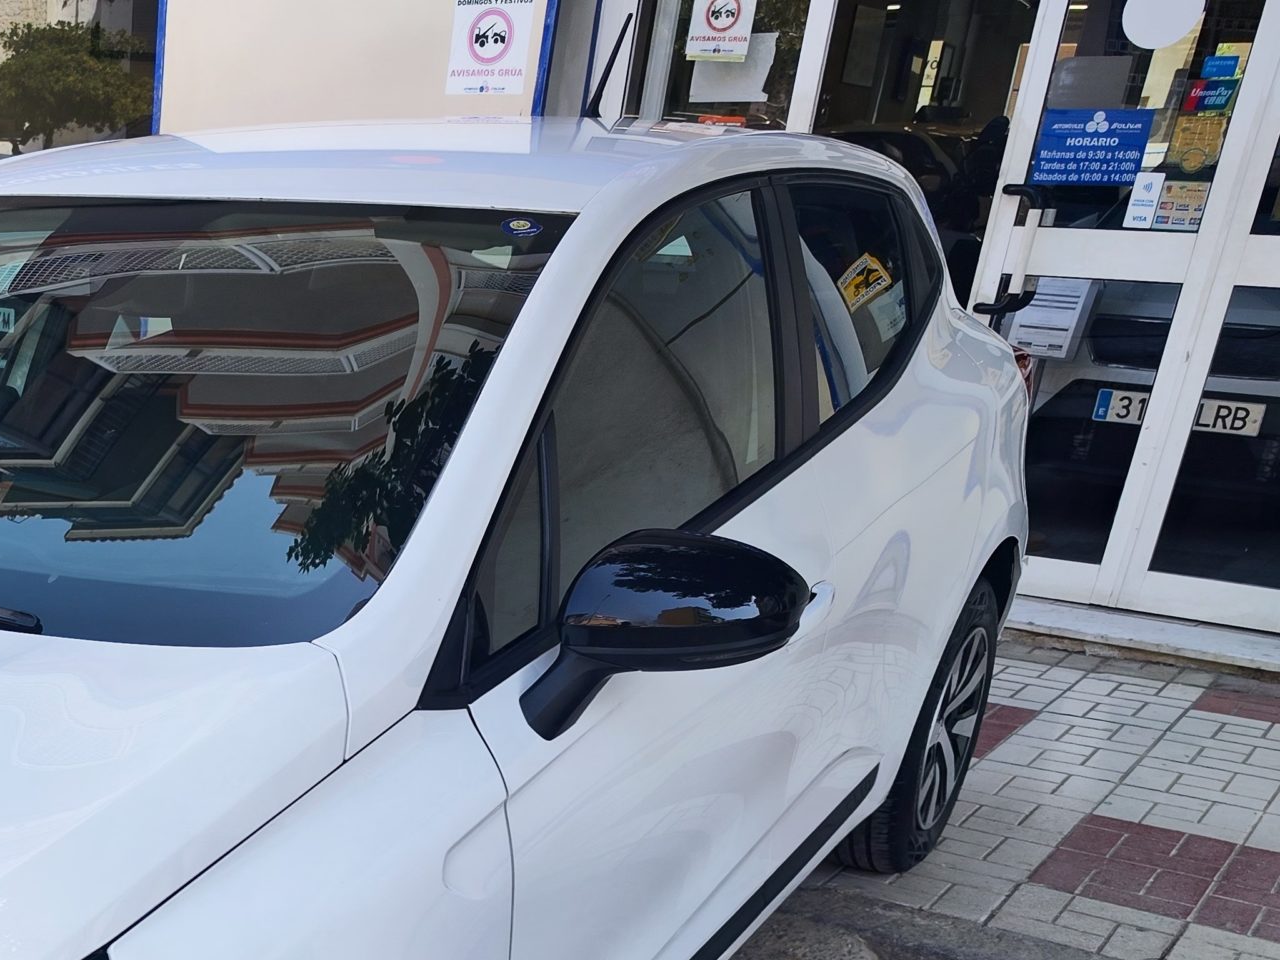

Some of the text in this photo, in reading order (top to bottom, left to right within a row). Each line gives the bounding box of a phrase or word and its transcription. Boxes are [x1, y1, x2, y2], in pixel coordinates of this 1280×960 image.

[450, 69, 496, 77] AVISAMOS
[1190, 87, 1233, 97] UnionPay
[1066, 137, 1119, 147] HORARIO
[1040, 150, 1074, 159] Mañanas
[1076, 150, 1086, 159] de
[1088, 151, 1105, 159] 9:30
[1114, 151, 1140, 160] 14:00h
[1040, 161, 1065, 170] Tardes
[1067, 161, 1077, 170] de
[1079, 162, 1100, 170] 17:00
[1108, 162, 1135, 171] 21:00h
[1033, 171, 1067, 181] Sábados
[1068, 172, 1078, 181] de
[1080, 173, 1101, 181] 10:00
[1115, 396, 1251, 431] 31 LRB
